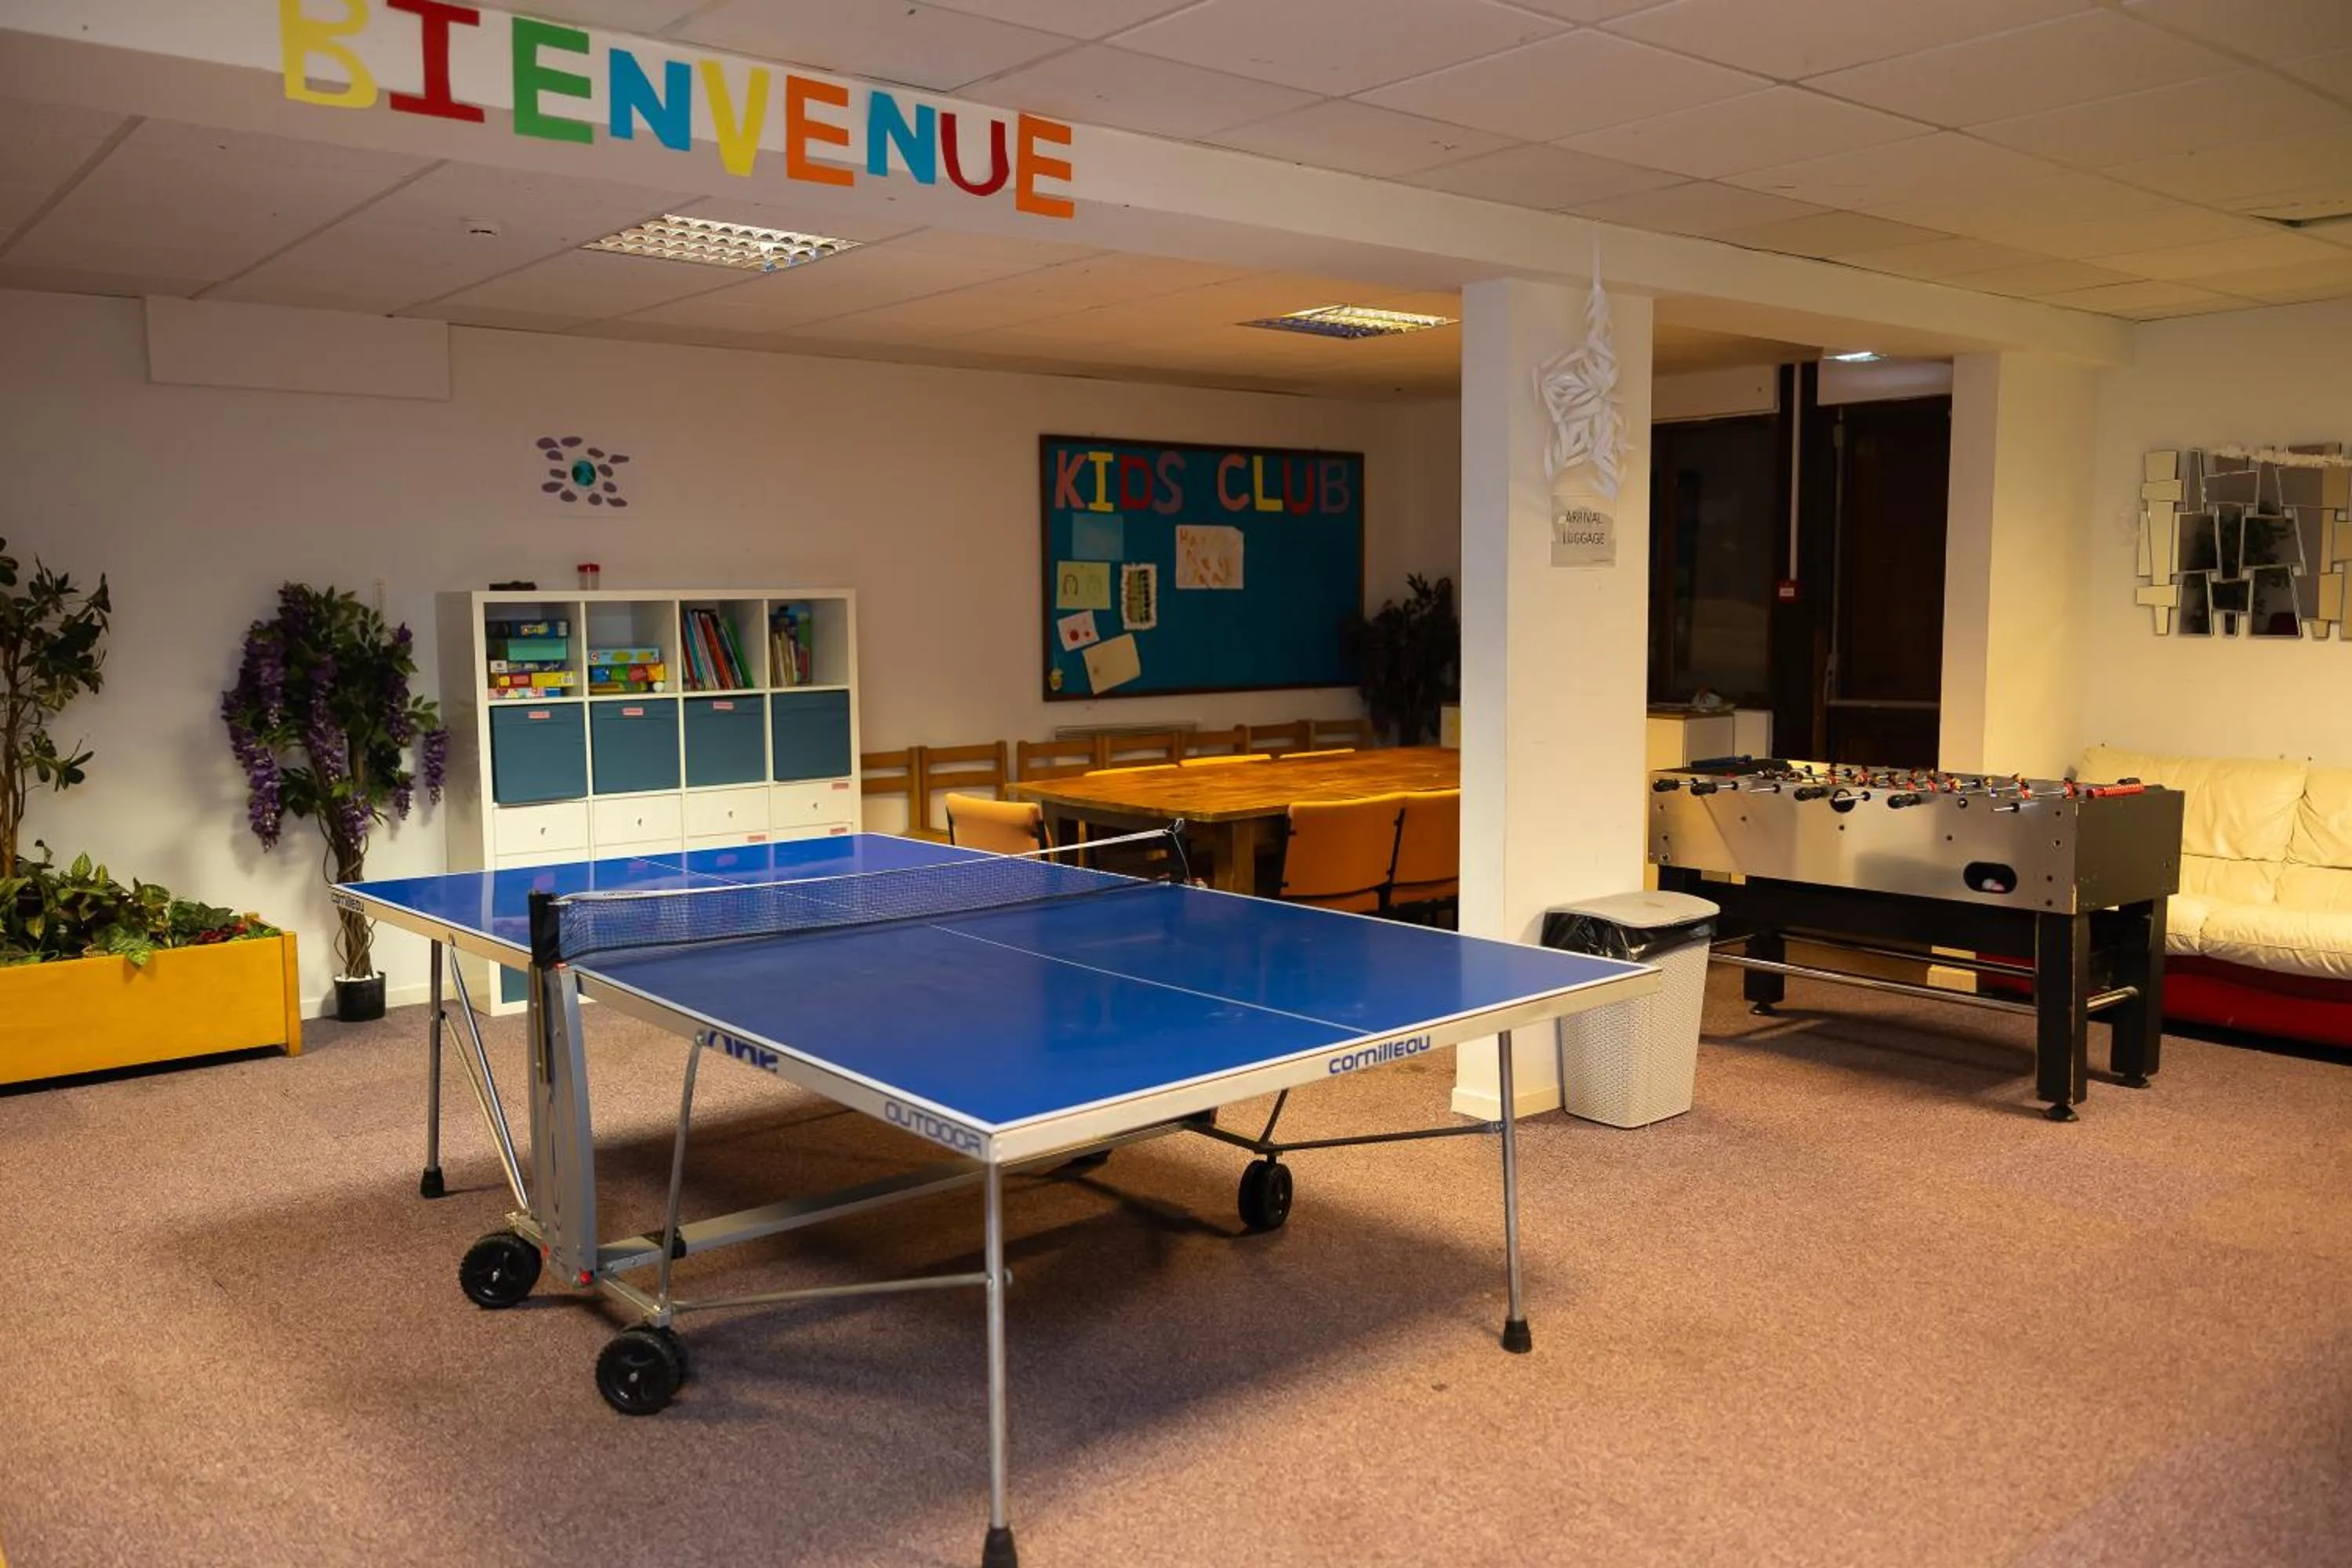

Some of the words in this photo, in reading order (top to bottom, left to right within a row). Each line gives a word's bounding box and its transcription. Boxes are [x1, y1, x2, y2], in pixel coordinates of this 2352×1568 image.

[279, 0, 1074, 218] BIENVENUE
[1054, 450, 1186, 514] KIDS
[1217, 453, 1349, 516] CLUB
[1562, 532, 1606, 545] LUGGAGE
[1328, 1034, 1432, 1074] cornilleau
[885, 1101, 982, 1156] OUTDOOR
